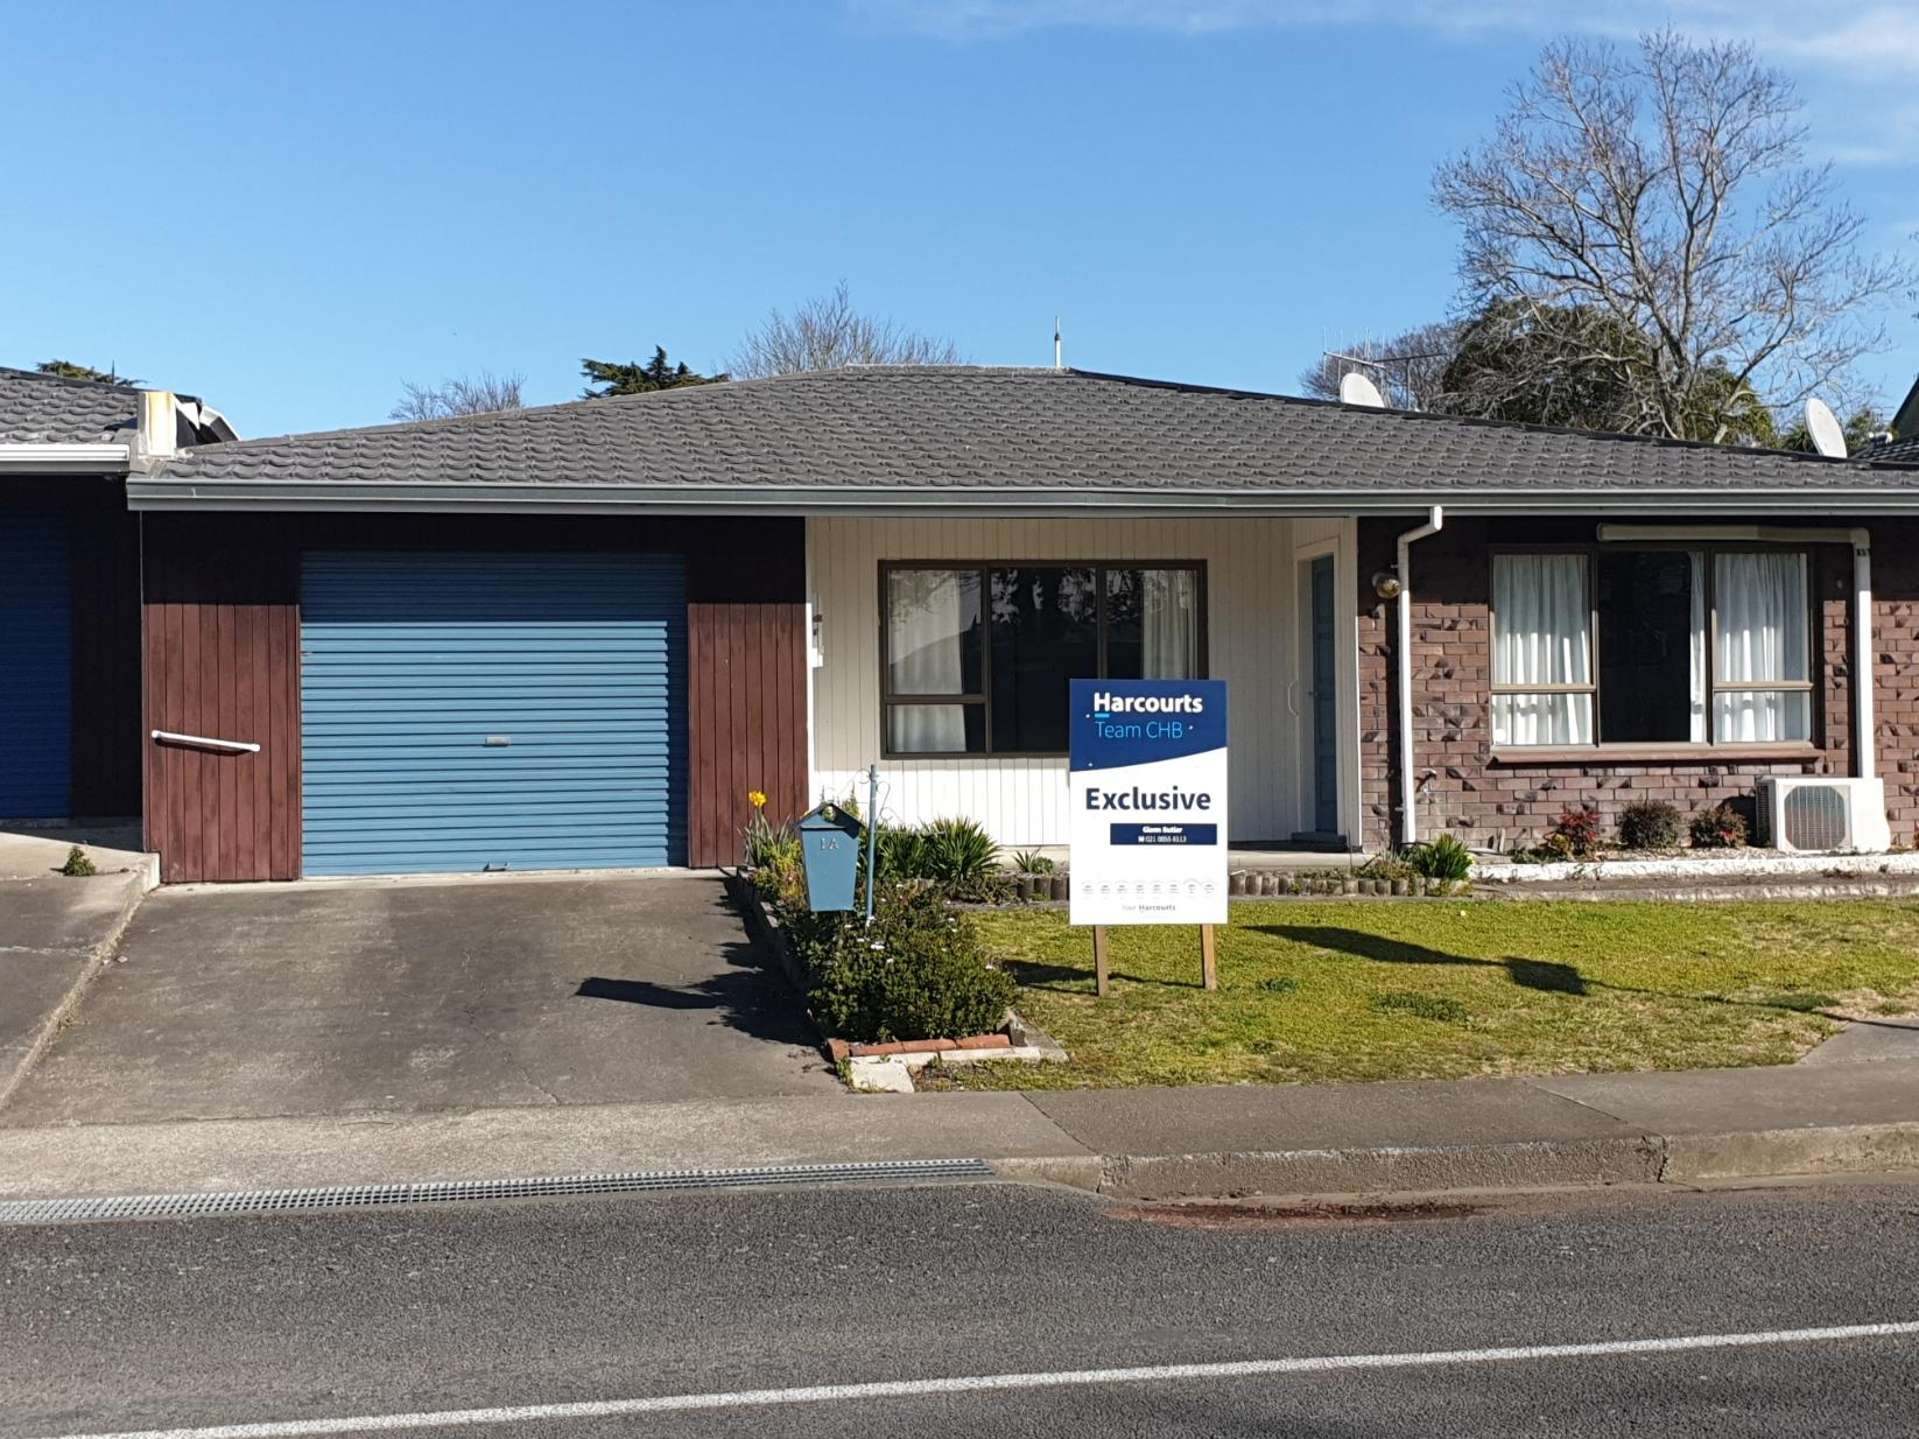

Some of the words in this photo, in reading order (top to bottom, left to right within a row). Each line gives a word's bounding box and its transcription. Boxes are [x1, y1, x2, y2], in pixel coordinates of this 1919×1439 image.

[1093, 691, 1204, 713] Harcourts
[1094, 721, 1141, 738] Team
[1145, 720, 1184, 739] CHB
[1085, 785, 1211, 810] Exclusive
